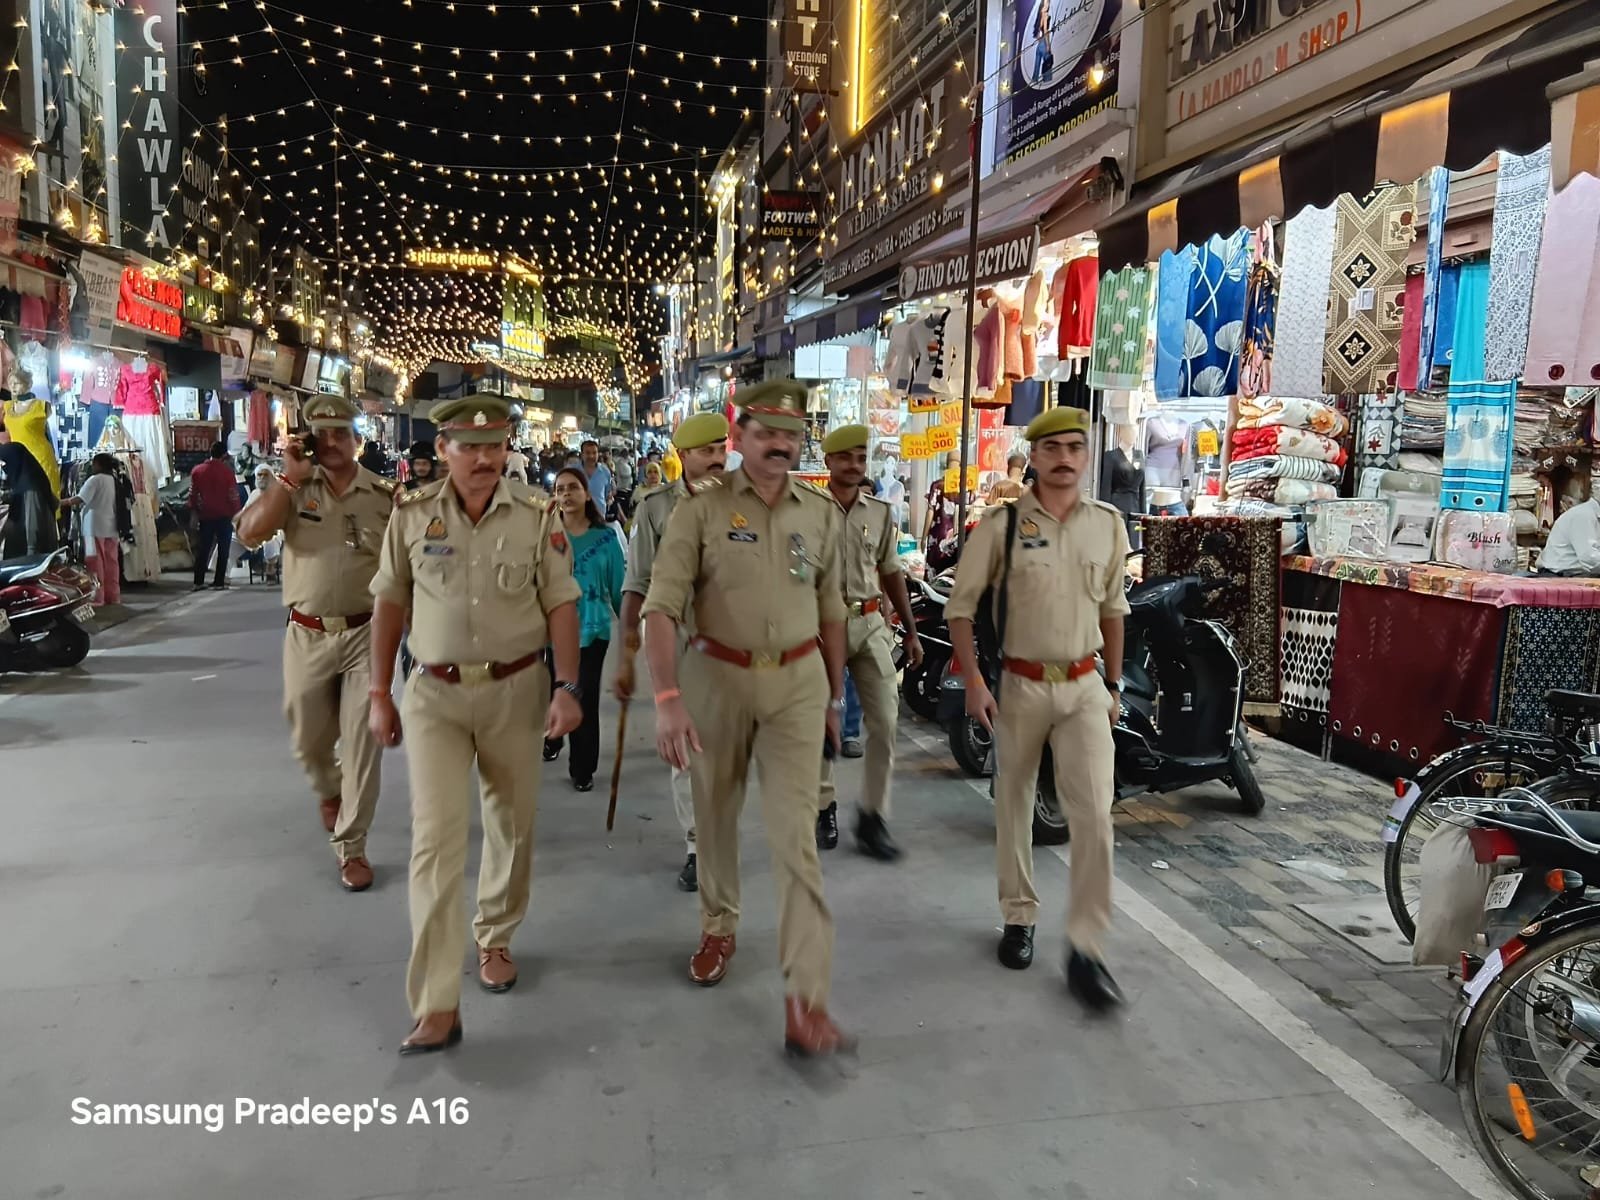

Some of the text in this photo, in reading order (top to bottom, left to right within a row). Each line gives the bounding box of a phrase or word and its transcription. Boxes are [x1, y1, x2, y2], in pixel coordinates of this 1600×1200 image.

[786, 50, 828, 65] WEDDING
[793, 64, 821, 77] STORE
[137, 14, 172, 249] CHAWLA
[838, 78, 945, 217] MANNAT
[899, 209, 937, 250] COSMETICS
[917, 235, 1032, 292] HIND COLECTION
[181, 436, 210, 452] 1930
[932, 438, 954, 449] 300
[1467, 531, 1502, 544] Blush
